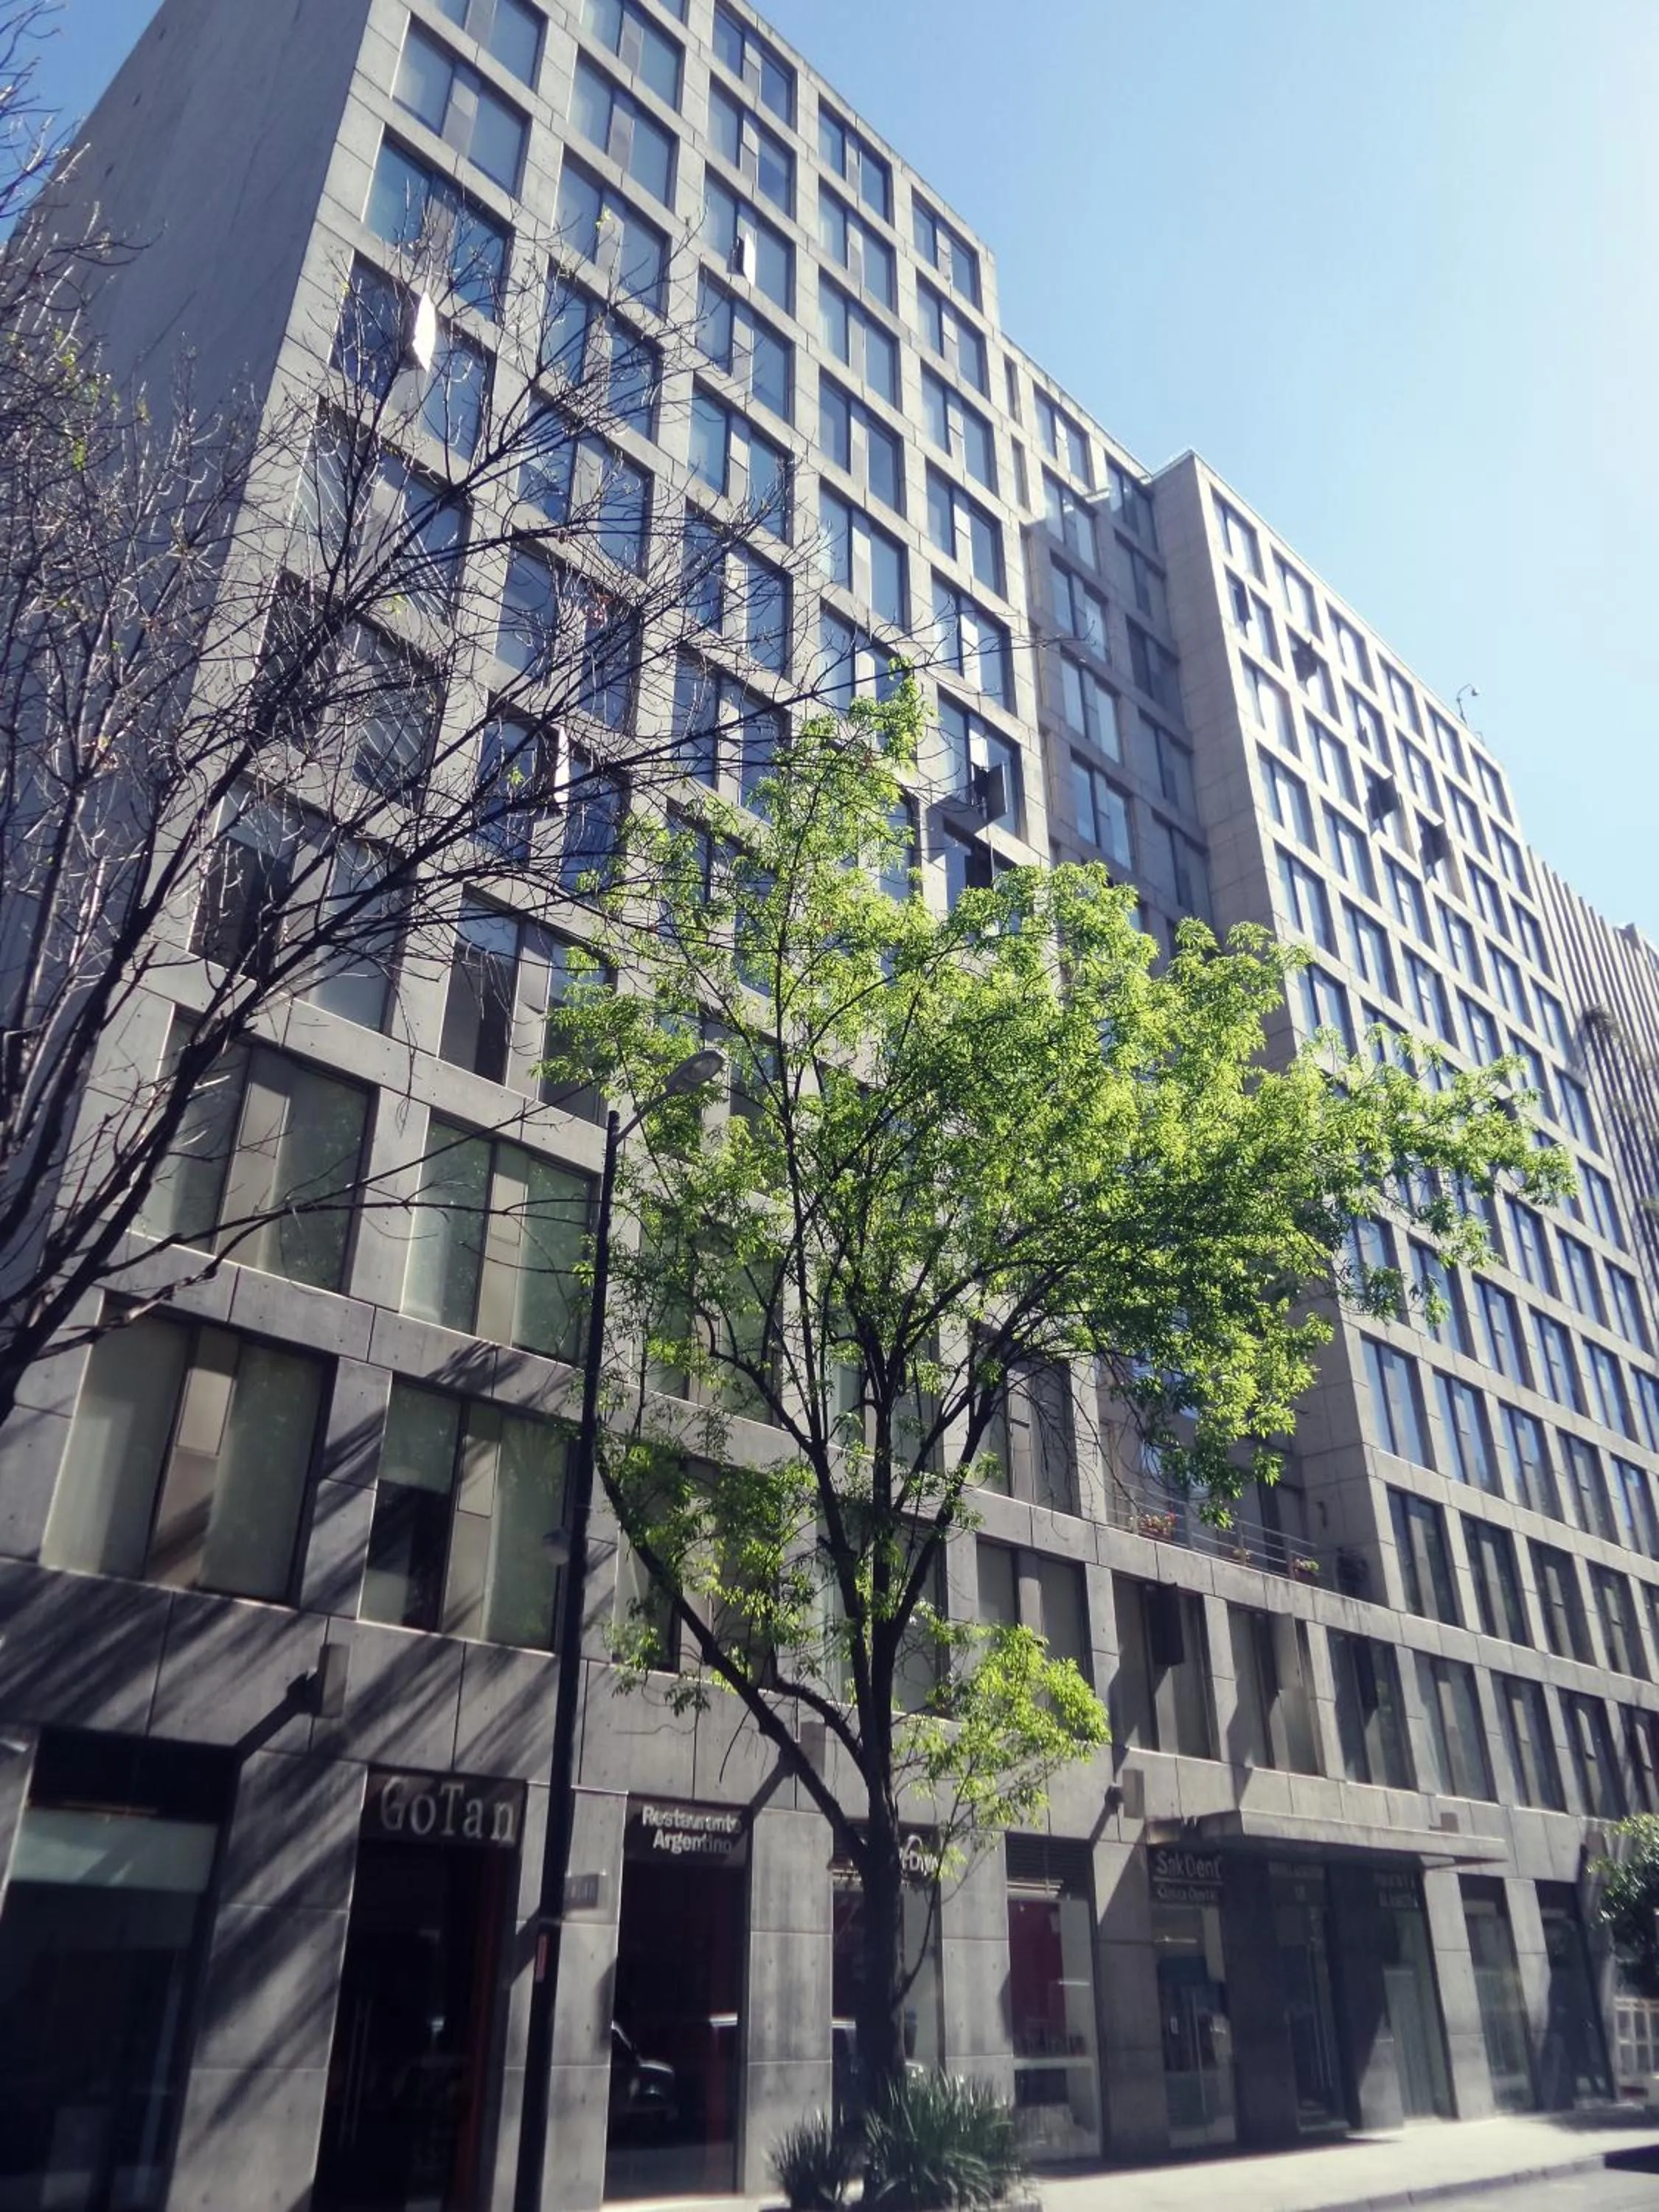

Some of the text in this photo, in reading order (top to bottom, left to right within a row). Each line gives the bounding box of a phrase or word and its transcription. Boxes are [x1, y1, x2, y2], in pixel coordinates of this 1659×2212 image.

[380, 1775, 516, 1846] GoTan
[642, 1804, 742, 1834] Restaurante
[653, 1828, 732, 1854] Argentino
